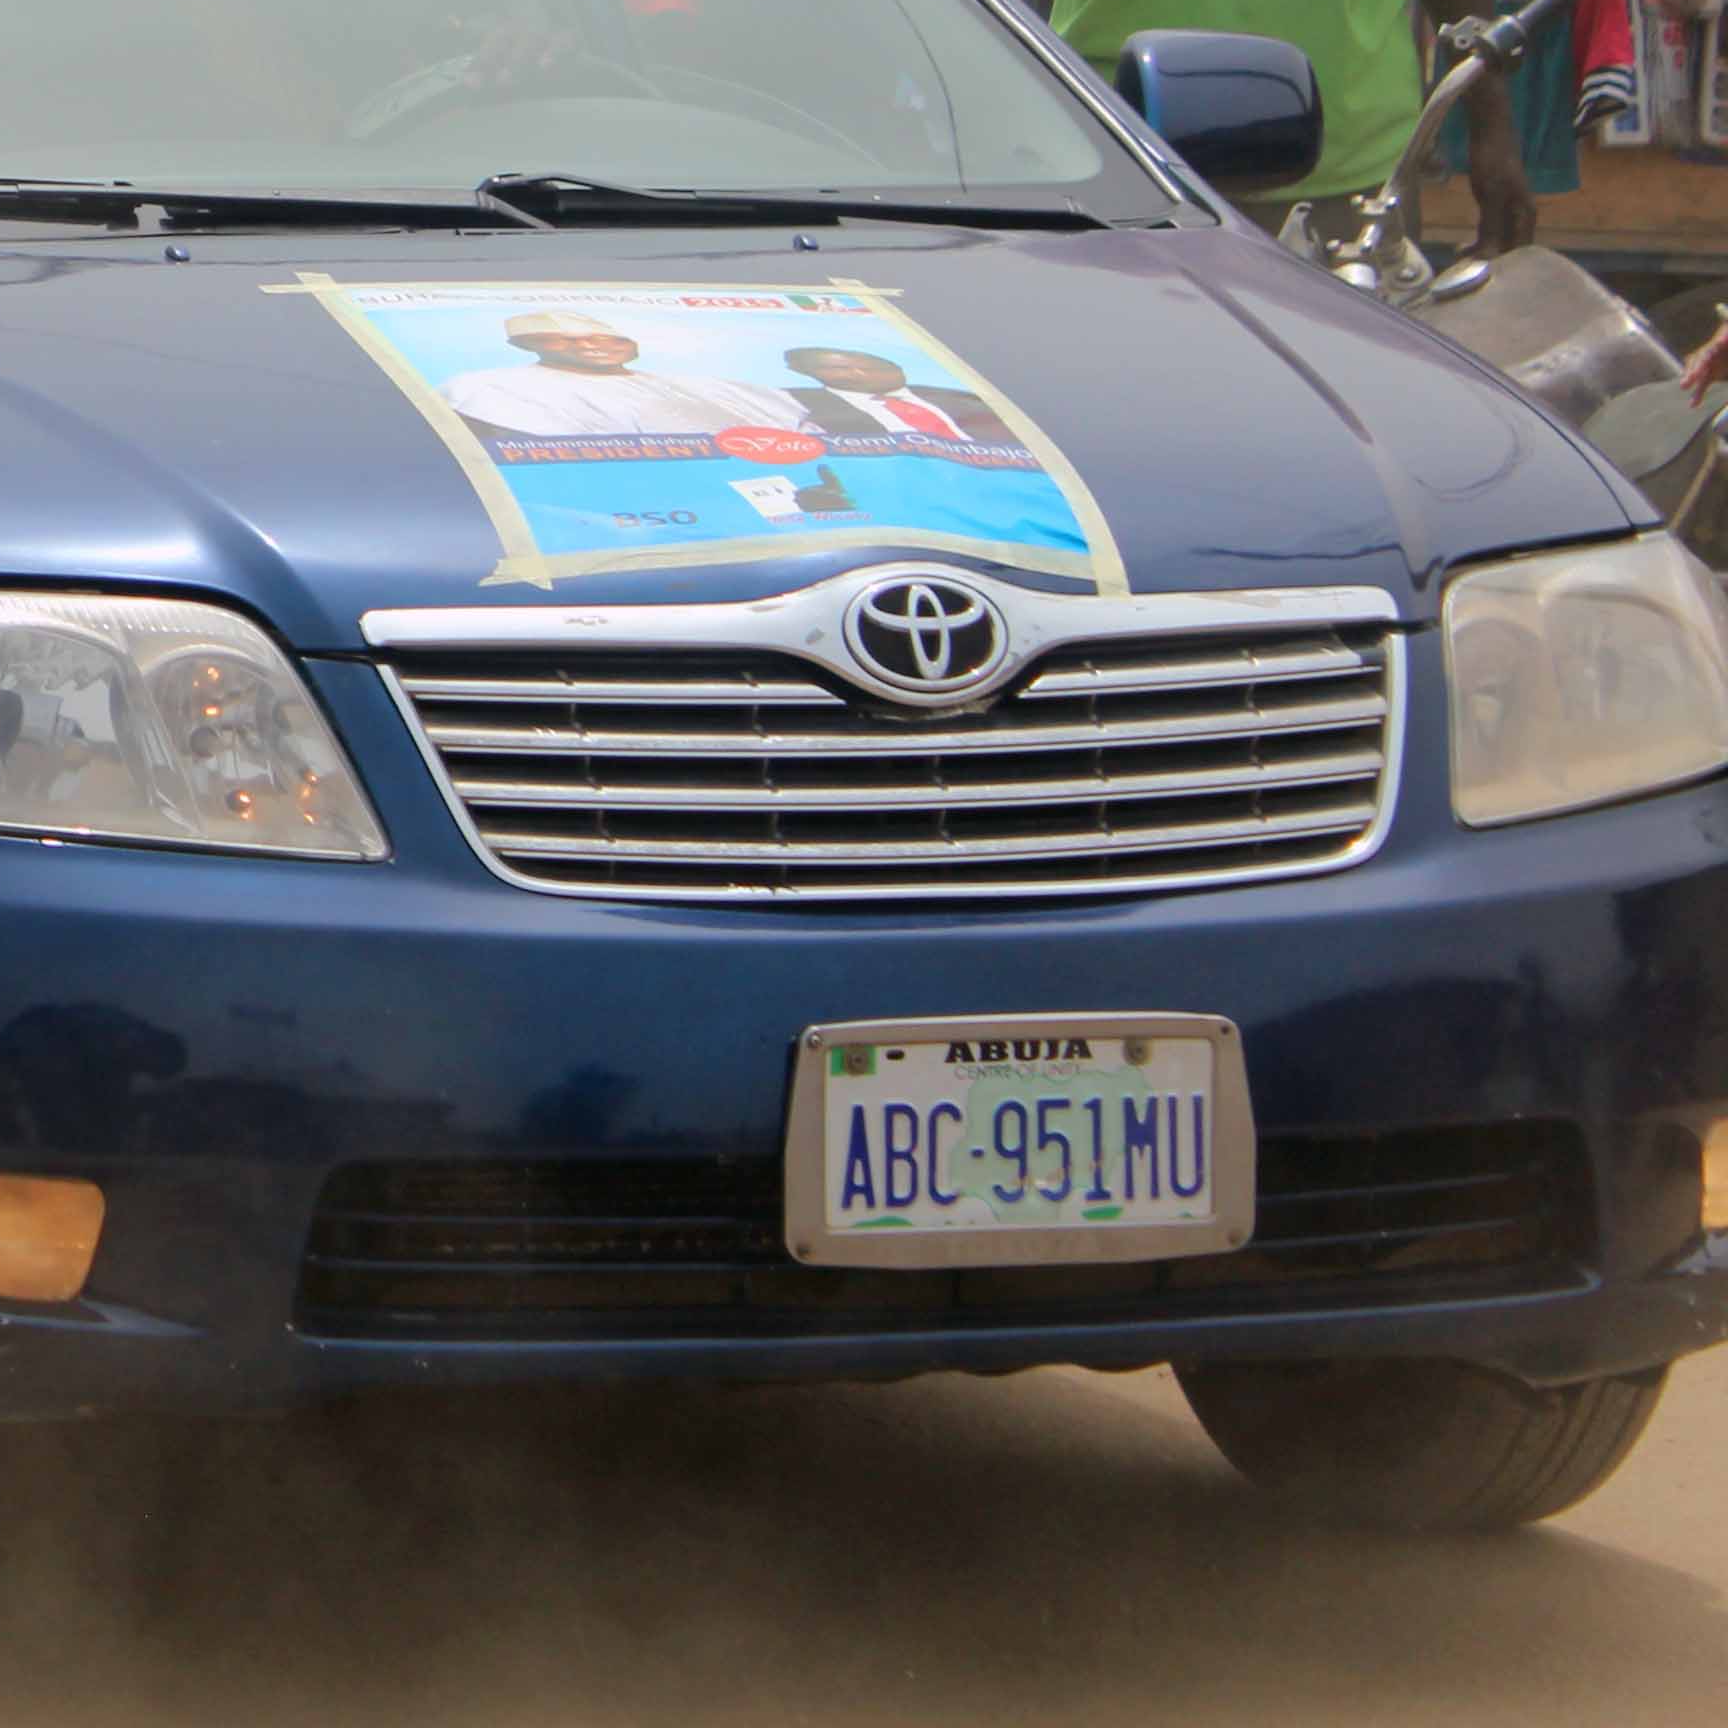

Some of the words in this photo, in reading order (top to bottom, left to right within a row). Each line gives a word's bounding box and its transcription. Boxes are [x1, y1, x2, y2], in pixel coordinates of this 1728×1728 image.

[496, 438, 635, 450] Muhammadu
[502, 446, 713, 461] PRESIDENT
[719, 434, 818, 452] Vote
[821, 434, 897, 448] Yemi
[904, 434, 1033, 459] Osinbajo
[945, 1038, 1093, 1063] ABUJA
[841, 1095, 1205, 1209] ABC-951MU
